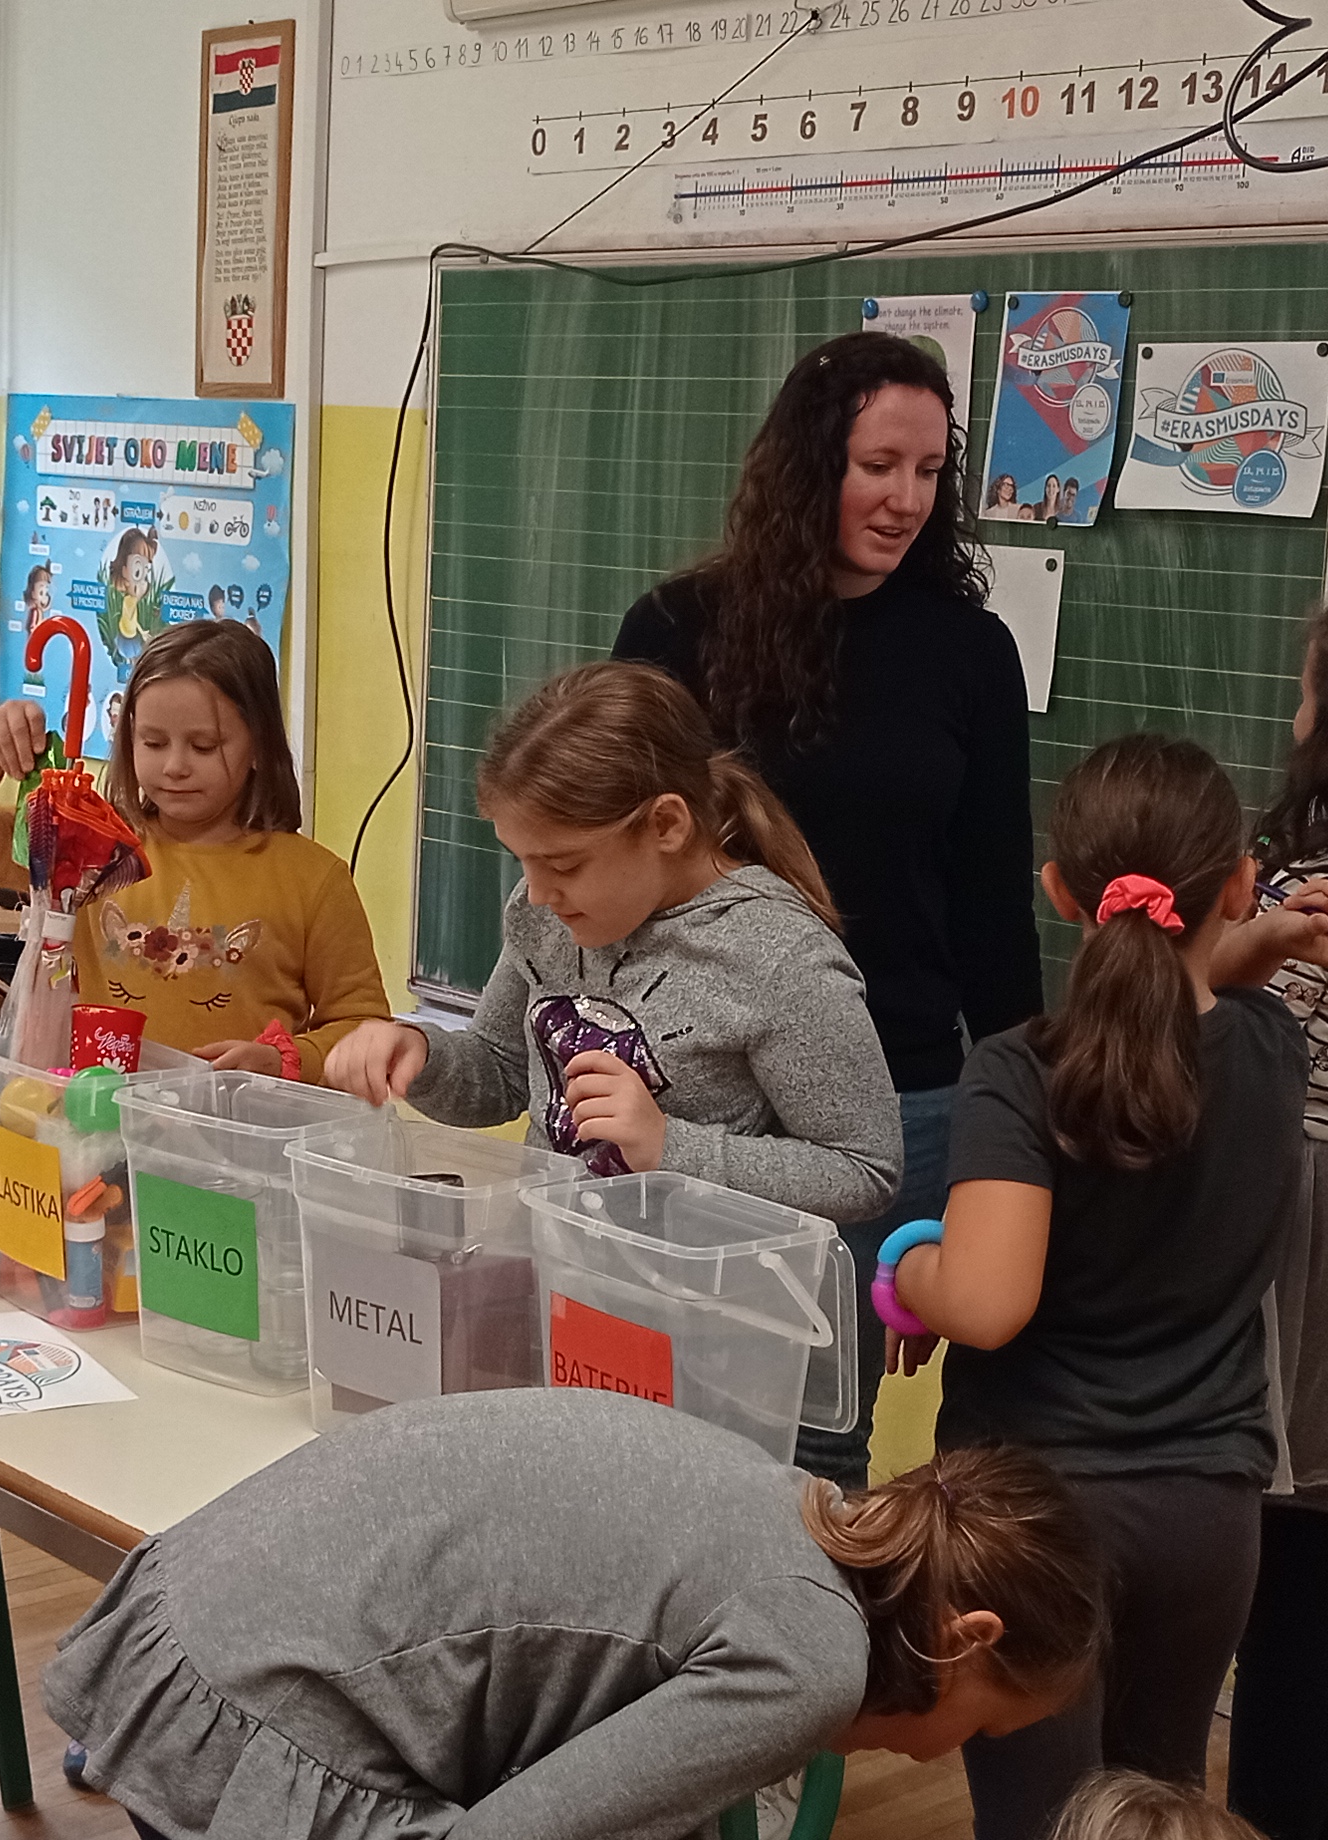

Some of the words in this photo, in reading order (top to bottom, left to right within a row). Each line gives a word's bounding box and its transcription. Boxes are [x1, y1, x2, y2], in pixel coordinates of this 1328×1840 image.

[341, 56, 350, 75] 0
[356, 55, 362, 74] 1
[370, 54, 379, 73] 2
[384, 52, 391, 72] 3
[395, 51, 403, 72] 4
[409, 49, 418, 71] 5
[425, 47, 436, 69] 6
[442, 45, 452, 66] 7
[458, 44, 466, 66] 8
[472, 43, 482, 64] 9
[492, 41, 507, 61] 10
[514, 37, 529, 59] 11
[538, 35, 554, 56] 12
[562, 33, 576, 53] 13
[586, 30, 600, 51] 14
[611, 27, 625, 49] 15
[634, 26, 648, 46] 16
[657, 23, 673, 44] 17
[685, 21, 701, 42] 18
[710, 18, 727, 41] 19
[732, 18, 747, 41] 20
[755, 13, 771, 37] 21
[779, 10, 798, 35] 22
[829, 4, 851, 29] 24
[859, 1, 880, 27] 25
[888, 0, 910, 24] 26
[531, 128, 546, 156] 0
[573, 127, 585, 154] 1
[614, 124, 631, 151] 2
[661, 121, 677, 148] 3
[702, 117, 719, 145] 4
[751, 113, 768, 142] 5
[799, 111, 817, 140] 6
[850, 102, 867, 131] 7
[901, 96, 919, 126] 8
[957, 90, 976, 122] 9
[1001, 85, 1040, 120] 10
[1060, 81, 1097, 115] 11
[1118, 76, 1159, 111] 12
[1181, 70, 1223, 105] 13
[1245, 62, 1288, 99] 14
[836, 203, 844, 211] 30
[1112, 186, 1122, 195] 80
[1174, 183, 1184, 192] 90
[1236, 180, 1250, 190] 100
[909, 319, 920, 330] the
[919, 305, 932, 317] the
[1020, 346, 1108, 368] #ERASMUSDAYS
[1160, 408, 1300, 439] #ERASMUSDAYS
[51, 433, 118, 466] SVIJET
[124, 437, 167, 469] OKO
[175, 440, 238, 475] MENE
[193, 499, 217, 512] NEŽIVO
[149, 1226, 244, 1278] STAKLO
[328, 1290, 423, 1346] METAL
